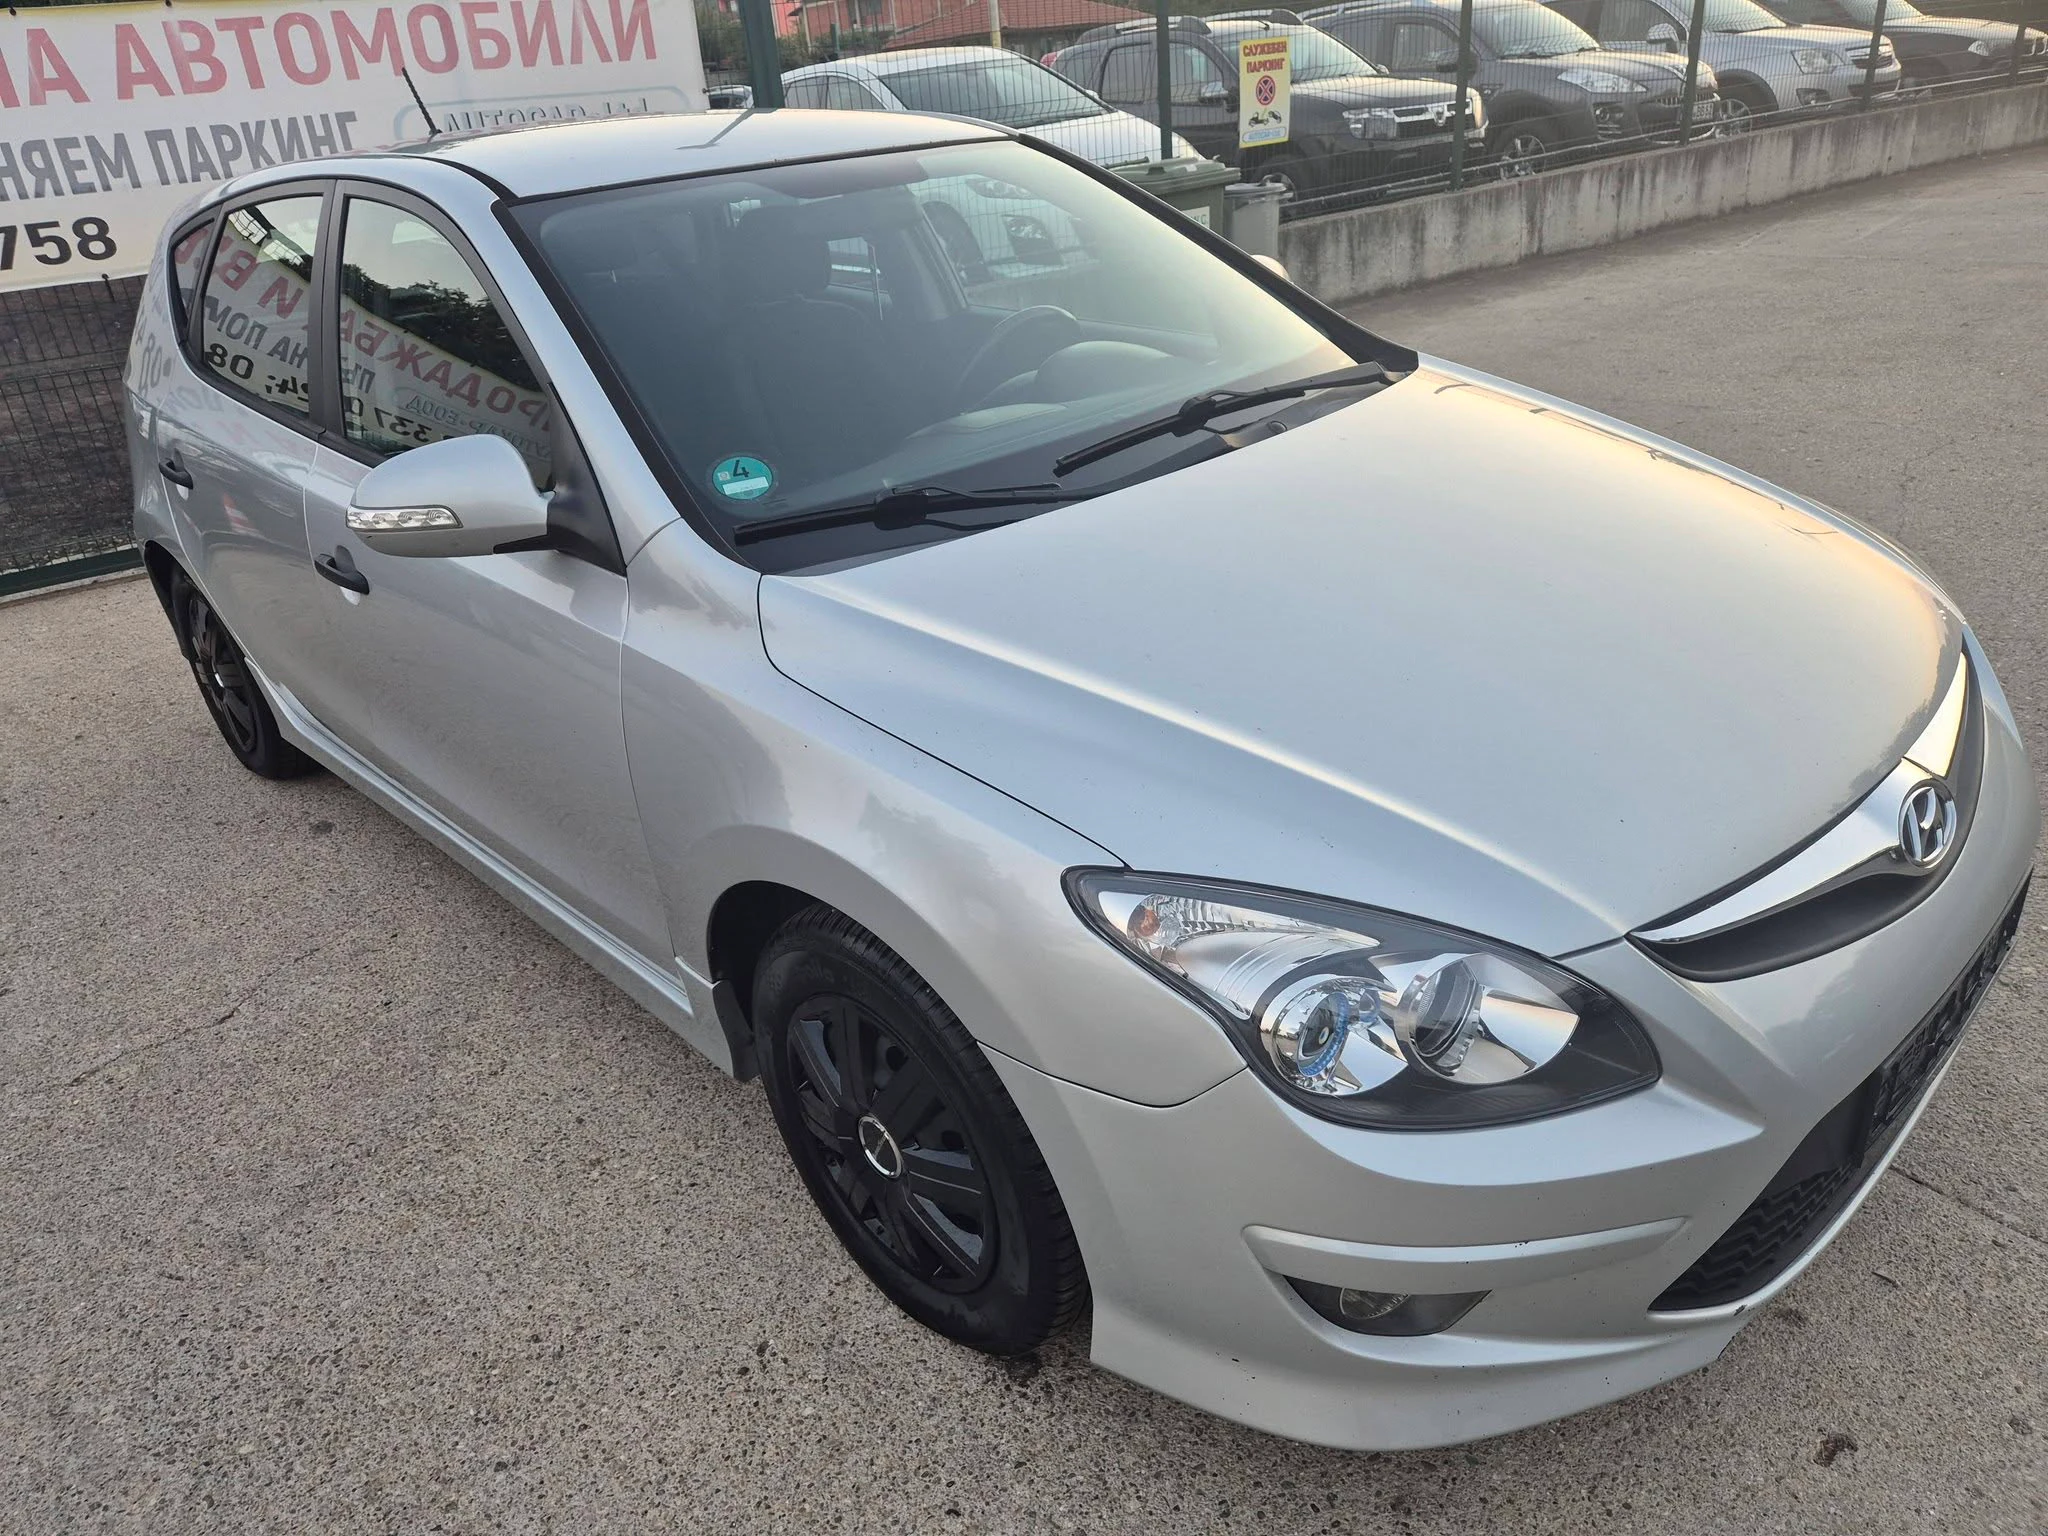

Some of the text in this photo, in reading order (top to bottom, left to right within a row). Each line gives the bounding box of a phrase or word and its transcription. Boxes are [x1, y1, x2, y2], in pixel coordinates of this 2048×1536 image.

[0, 0, 657, 108] А АВТОМОБИЛИ
[145, 111, 356, 186] ПАРКИНГ
[732, 459, 750, 478] 4
